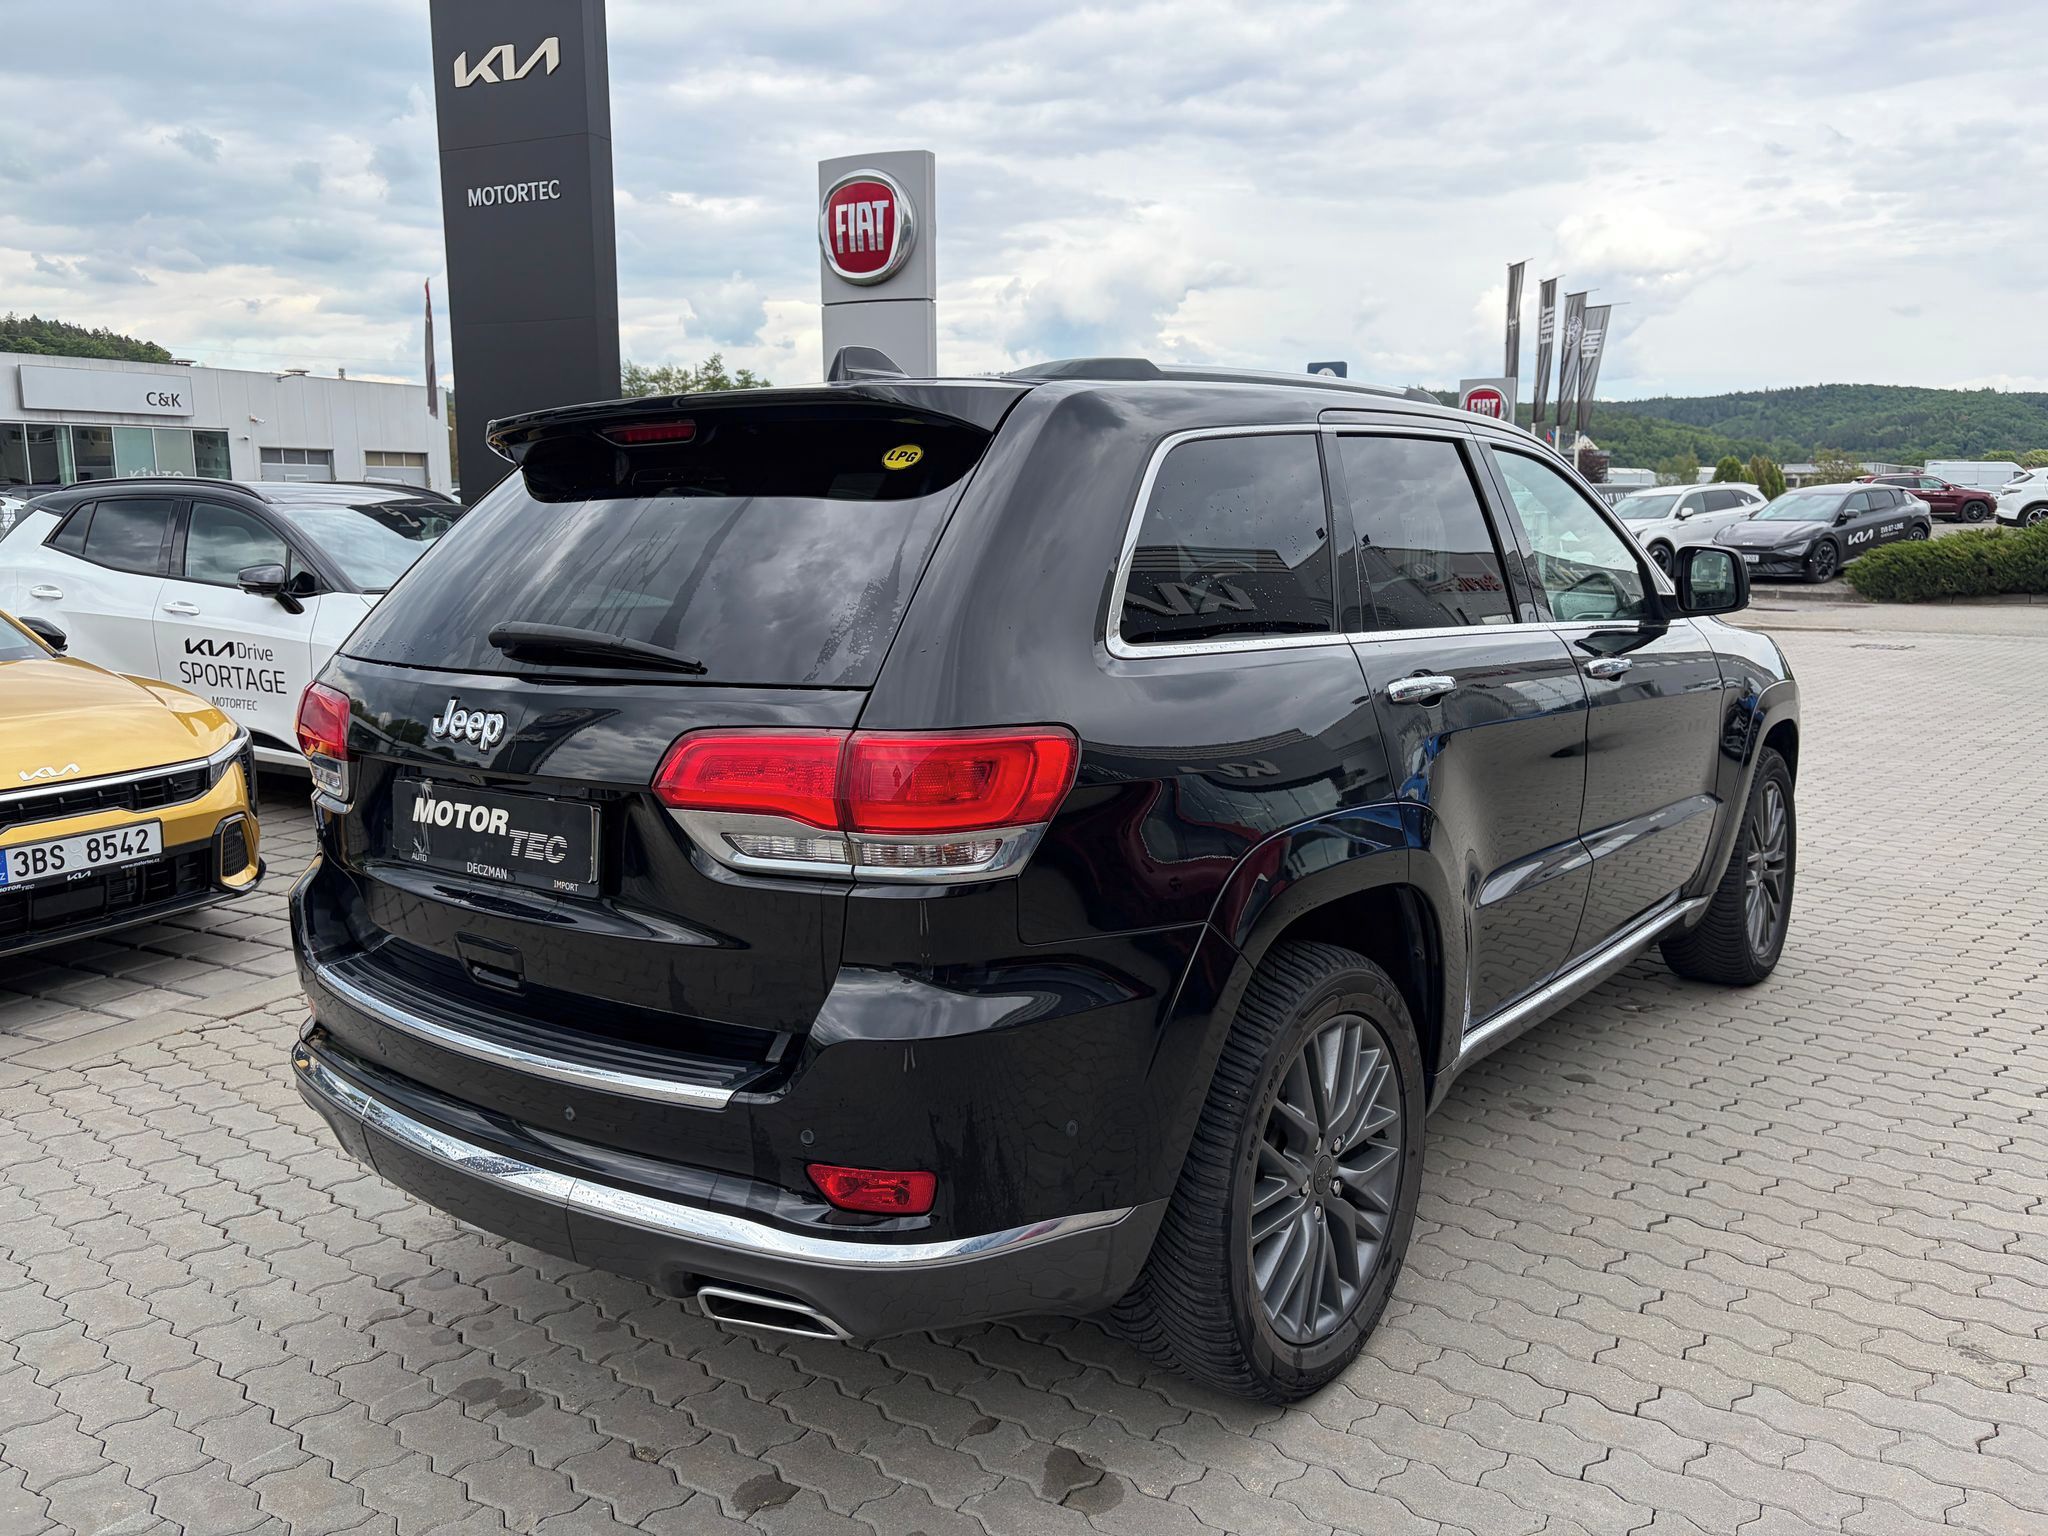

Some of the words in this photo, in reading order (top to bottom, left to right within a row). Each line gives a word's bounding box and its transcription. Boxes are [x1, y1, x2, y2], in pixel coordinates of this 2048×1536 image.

[453, 36, 560, 88] KIA
[467, 179, 561, 207] MOTORTEC
[835, 200, 890, 254] FIAT
[146, 391, 182, 408] C&K
[1470, 398, 1499, 418] FIAT
[886, 449, 919, 463] LPG
[1847, 528, 1874, 546] KIA
[184, 637, 235, 659] KIA
[237, 642, 274, 662] Drive
[179, 660, 288, 695] SPORTAGE
[211, 695, 259, 712] MOTORTEC
[432, 697, 505, 751] Jeep
[18, 763, 81, 781] KIA
[412, 797, 510, 836] MOTOR
[508, 829, 569, 865] TEC
[13, 844, 65, 878] 3BS
[86, 828, 150, 864] 8542
[411, 851, 428, 863] AUTO
[66, 870, 92, 882] KIA
[466, 861, 508, 881] DECZMAN
[553, 879, 580, 893] IMPORT
